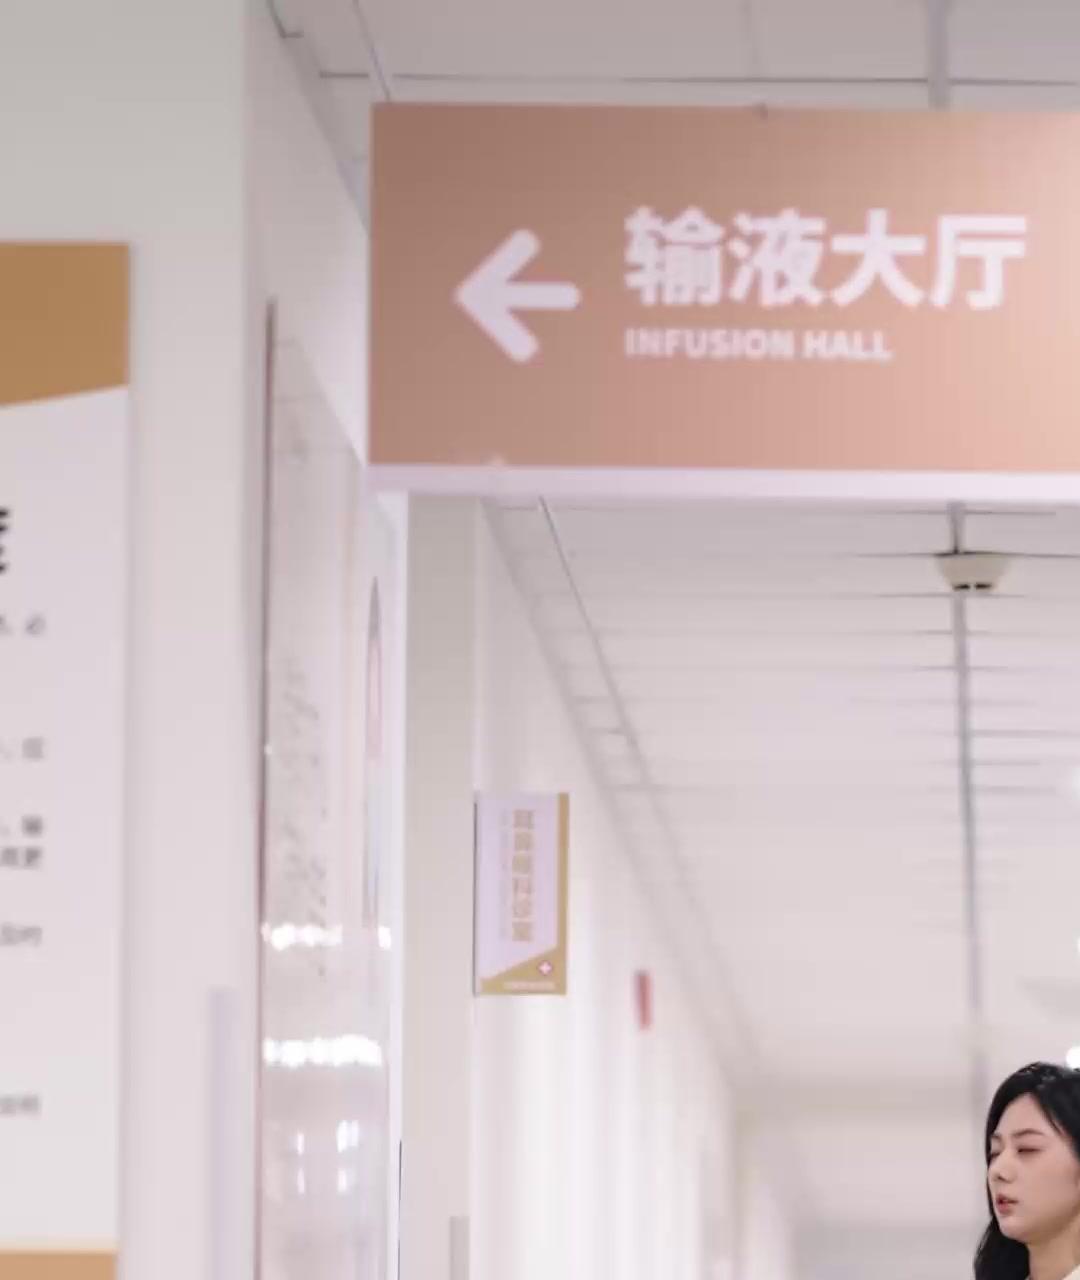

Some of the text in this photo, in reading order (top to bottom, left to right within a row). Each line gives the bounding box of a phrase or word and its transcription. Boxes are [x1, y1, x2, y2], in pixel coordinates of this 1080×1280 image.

[622, 206, 1028, 311] 输液大厅
[623, 327, 893, 362] INFUSION HALL
